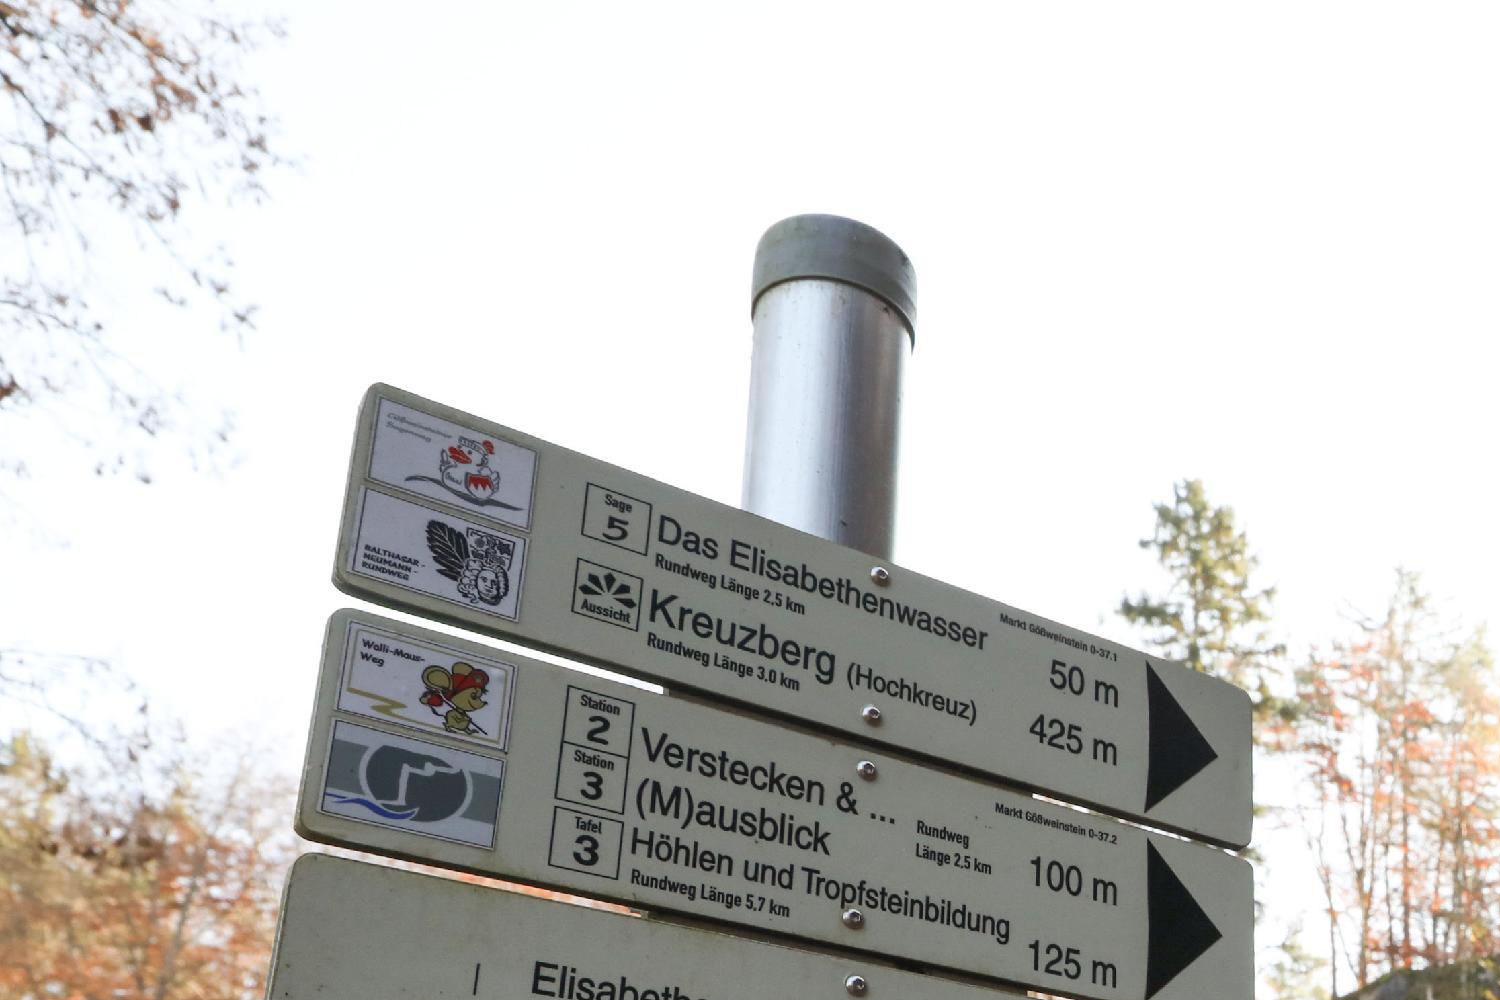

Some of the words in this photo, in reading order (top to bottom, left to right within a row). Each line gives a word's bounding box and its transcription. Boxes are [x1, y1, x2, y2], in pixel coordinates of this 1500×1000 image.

[605, 493, 632, 513] Sage
[602, 515, 629, 541] 5
[361, 560, 410, 581] RUNDWEG
[655, 553, 717, 589] Rundweg
[720, 574, 760, 600] Länge
[786, 596, 805, 615] km
[658, 514, 719, 560] Das
[729, 539, 988, 650] Elisabethenwasser
[580, 598, 631, 624] Aussicht
[649, 588, 836, 685] Kreuzberg
[847, 662, 977, 726] (Hochkreuz)
[1000, 612, 1027, 630] Markt
[1029, 624, 1088, 652] Gößweinstein
[1090, 644, 1117, 662] 0-37.1
[360, 651, 385, 667] Weg
[647, 632, 710, 668] Rundweg
[713, 652, 753, 678] Länge
[757, 666, 777, 684] 3.0
[780, 672, 799, 691] km
[580, 694, 621, 716] Station
[1050, 659, 1085, 696] 50
[1095, 679, 1119, 708] m
[586, 715, 611, 746] 2
[1029, 714, 1084, 755] 425
[1093, 738, 1117, 766] m
[574, 750, 614, 771] Station
[641, 727, 825, 806] Verstecken
[836, 781, 859, 815] &
[580, 771, 604, 800] 3
[575, 816, 602, 834] Tafel
[636, 778, 831, 856] (M)ausblick
[917, 820, 969, 849] Rundweg
[995, 802, 1022, 820] Markt
[1025, 812, 1086, 837] Gößweinstein
[1088, 828, 1118, 845] 0-37.2
[573, 835, 600, 867] 3
[916, 843, 950, 866] Länge
[974, 857, 992, 875] km
[631, 827, 733, 876] Höhlen
[744, 858, 795, 890] und
[801, 866, 1010, 945] Tropfsteinbildung
[631, 869, 696, 900] Rundweg
[701, 883, 742, 909] Länge
[745, 893, 766, 912] 5.7
[769, 899, 790, 917] km
[1030, 856, 1083, 896] 100
[1093, 877, 1118, 906] m
[1029, 939, 1082, 980] 125
[1092, 959, 1117, 989] m
